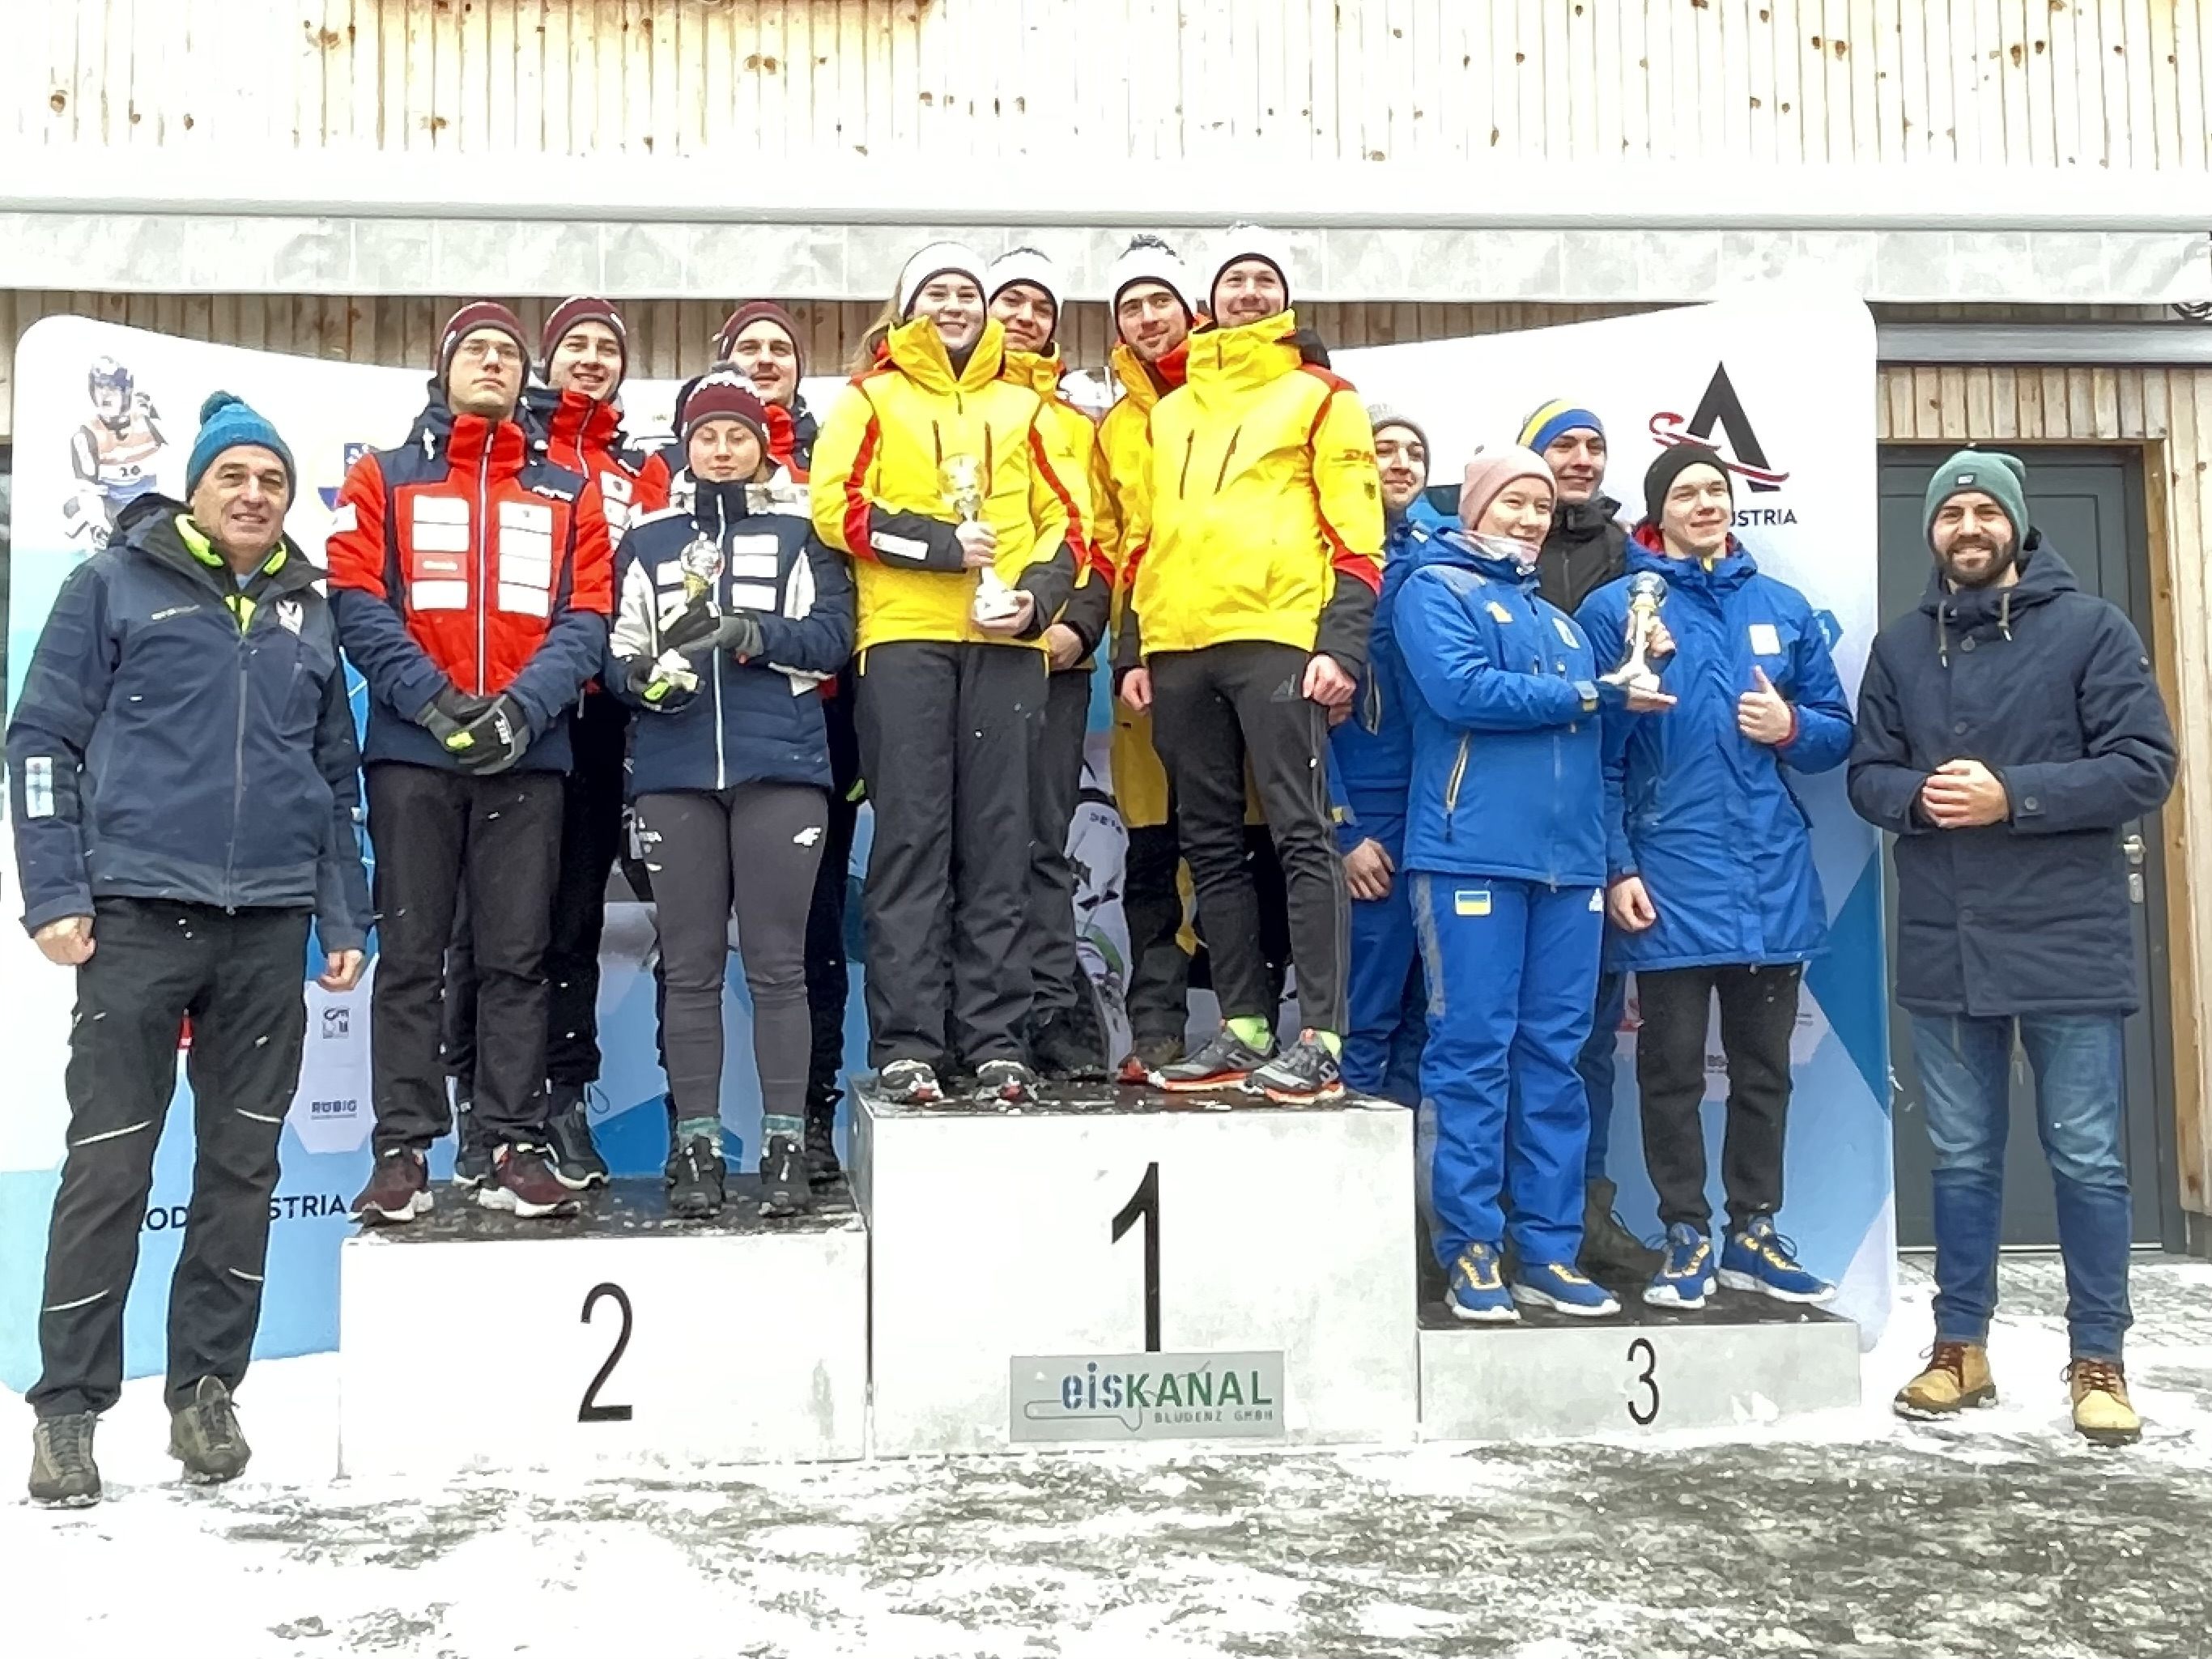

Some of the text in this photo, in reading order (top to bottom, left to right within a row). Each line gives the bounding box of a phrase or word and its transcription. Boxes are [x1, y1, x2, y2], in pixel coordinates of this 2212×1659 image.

[1730, 508, 1797, 527] STRIA
[268, 1194, 347, 1221] STRIA
[1112, 1162, 1159, 1352] 1
[578, 1282, 633, 1423] 2
[1627, 1337, 1660, 1425] 3
